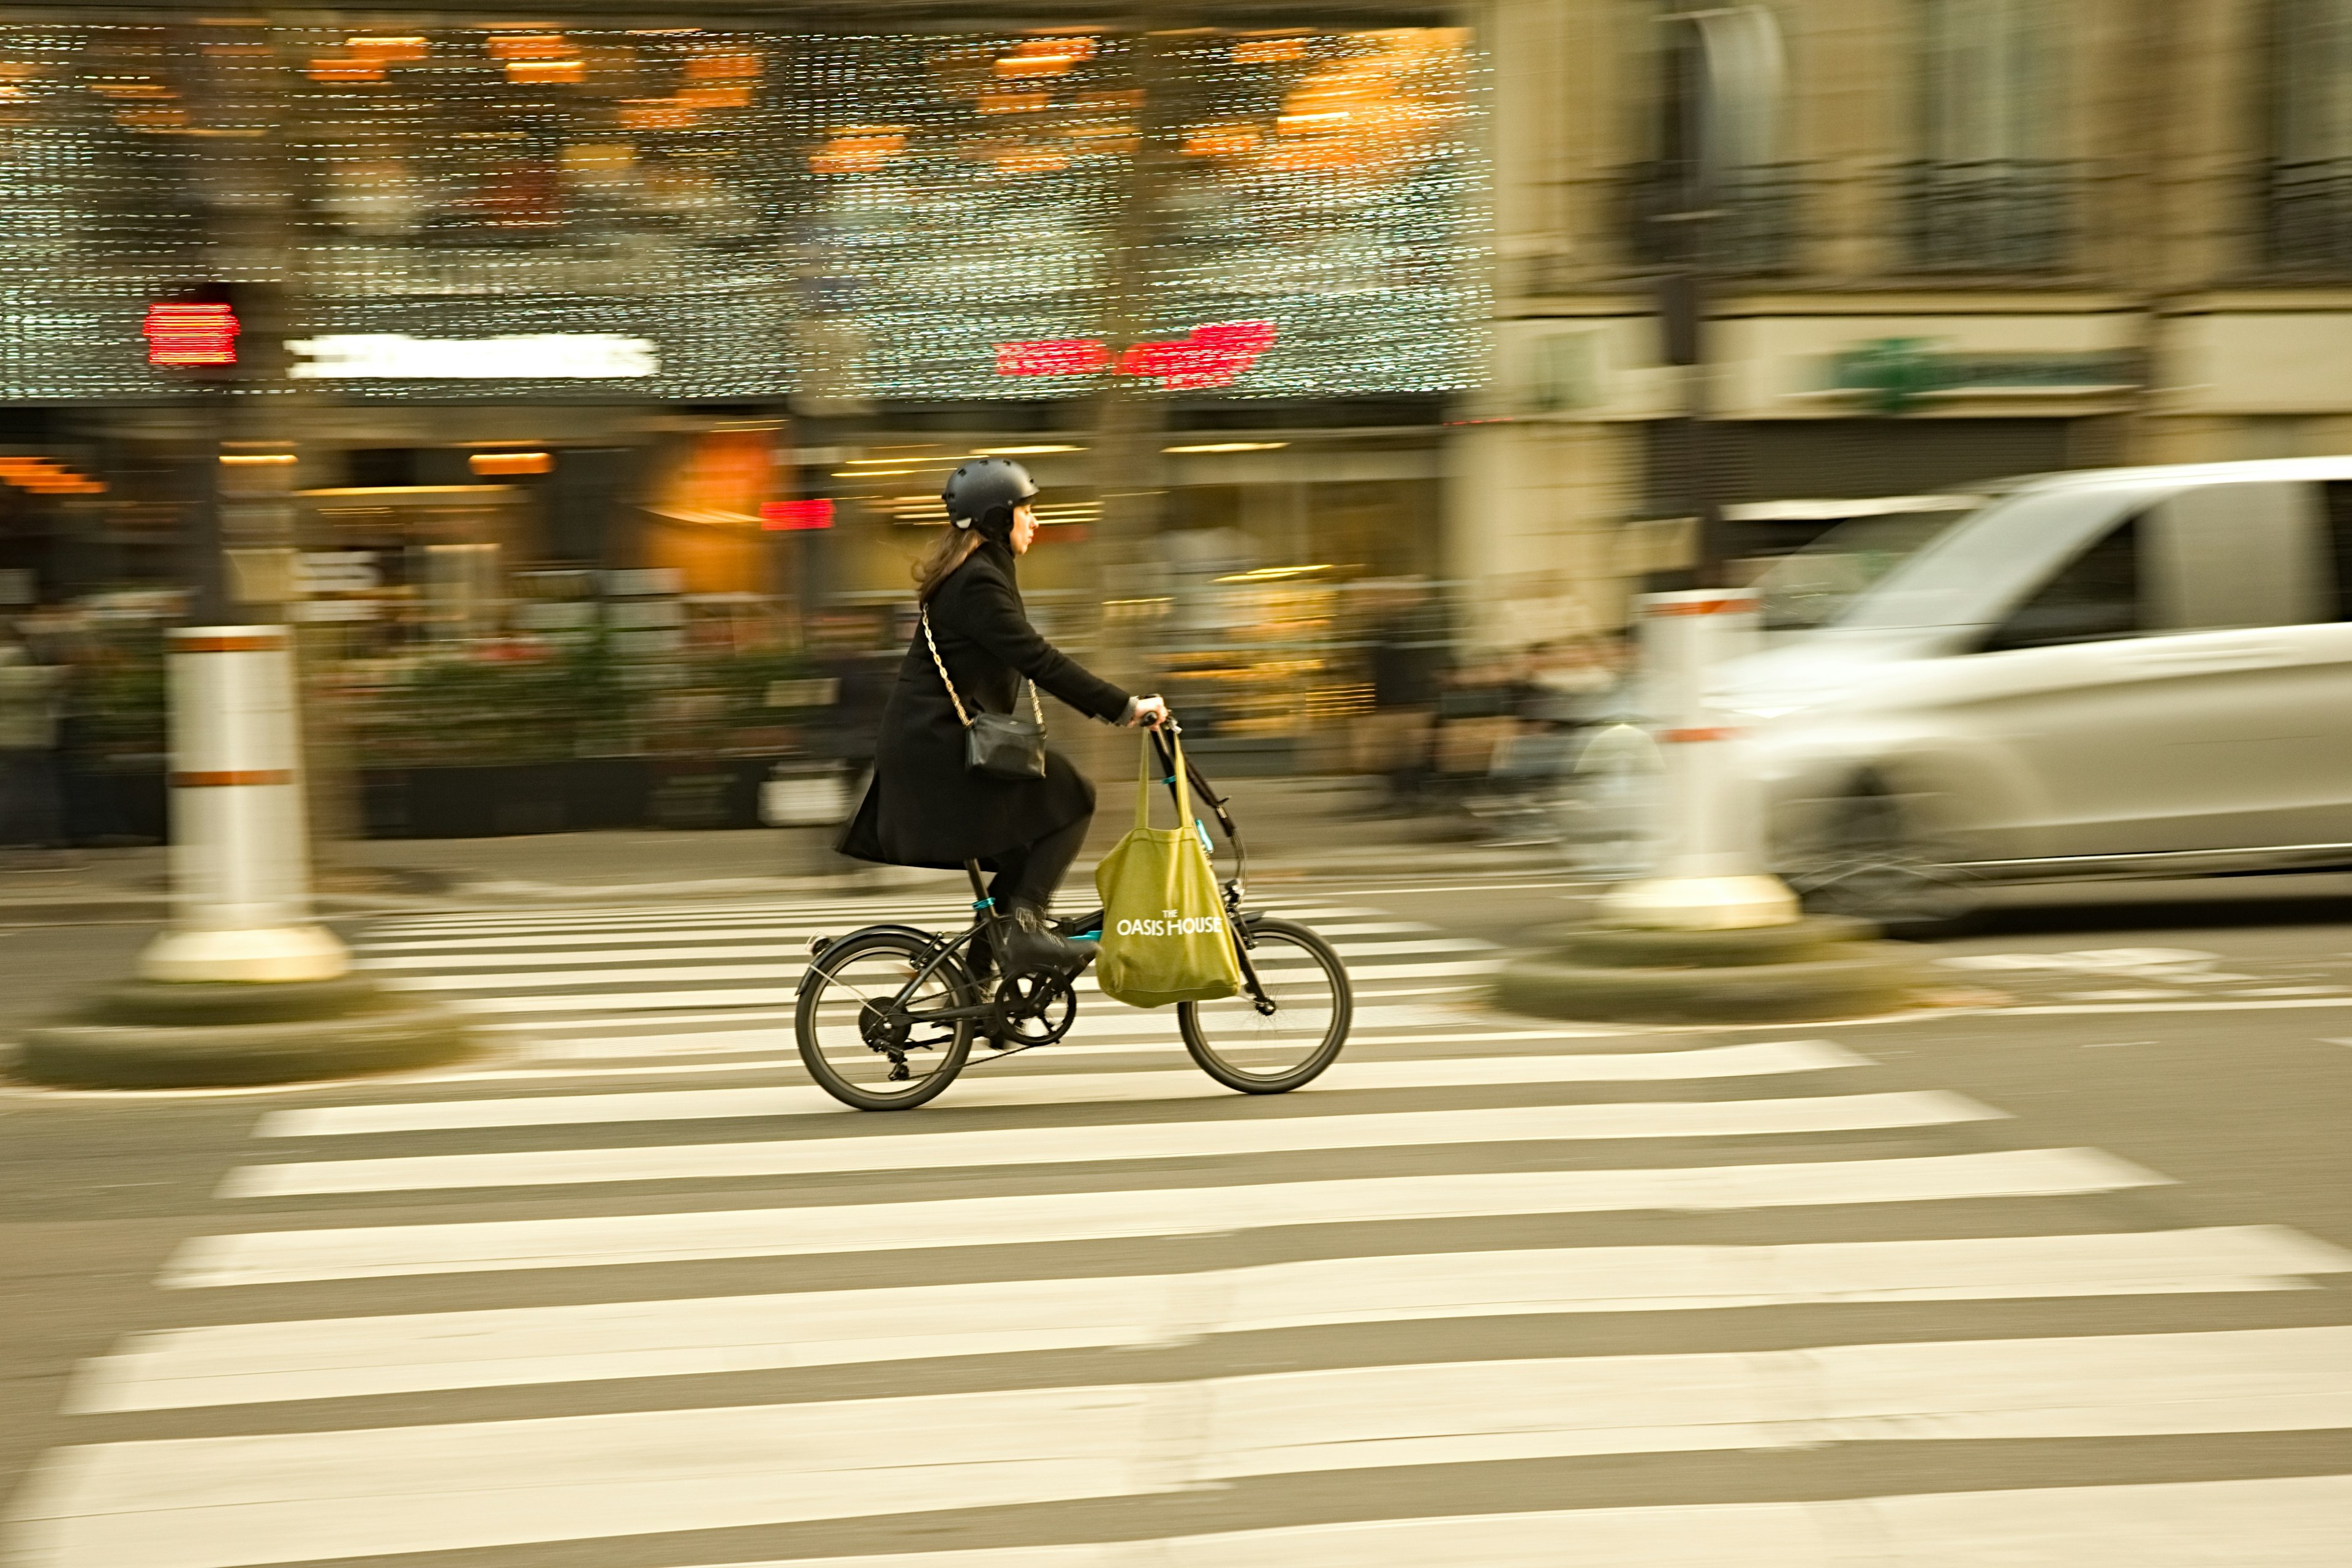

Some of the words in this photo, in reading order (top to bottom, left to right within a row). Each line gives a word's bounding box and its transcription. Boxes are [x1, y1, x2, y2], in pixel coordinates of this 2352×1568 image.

[1162, 910, 1178, 918] THE
[1117, 919, 1164, 936] OASIS
[1167, 917, 1223, 936] HOUSE
